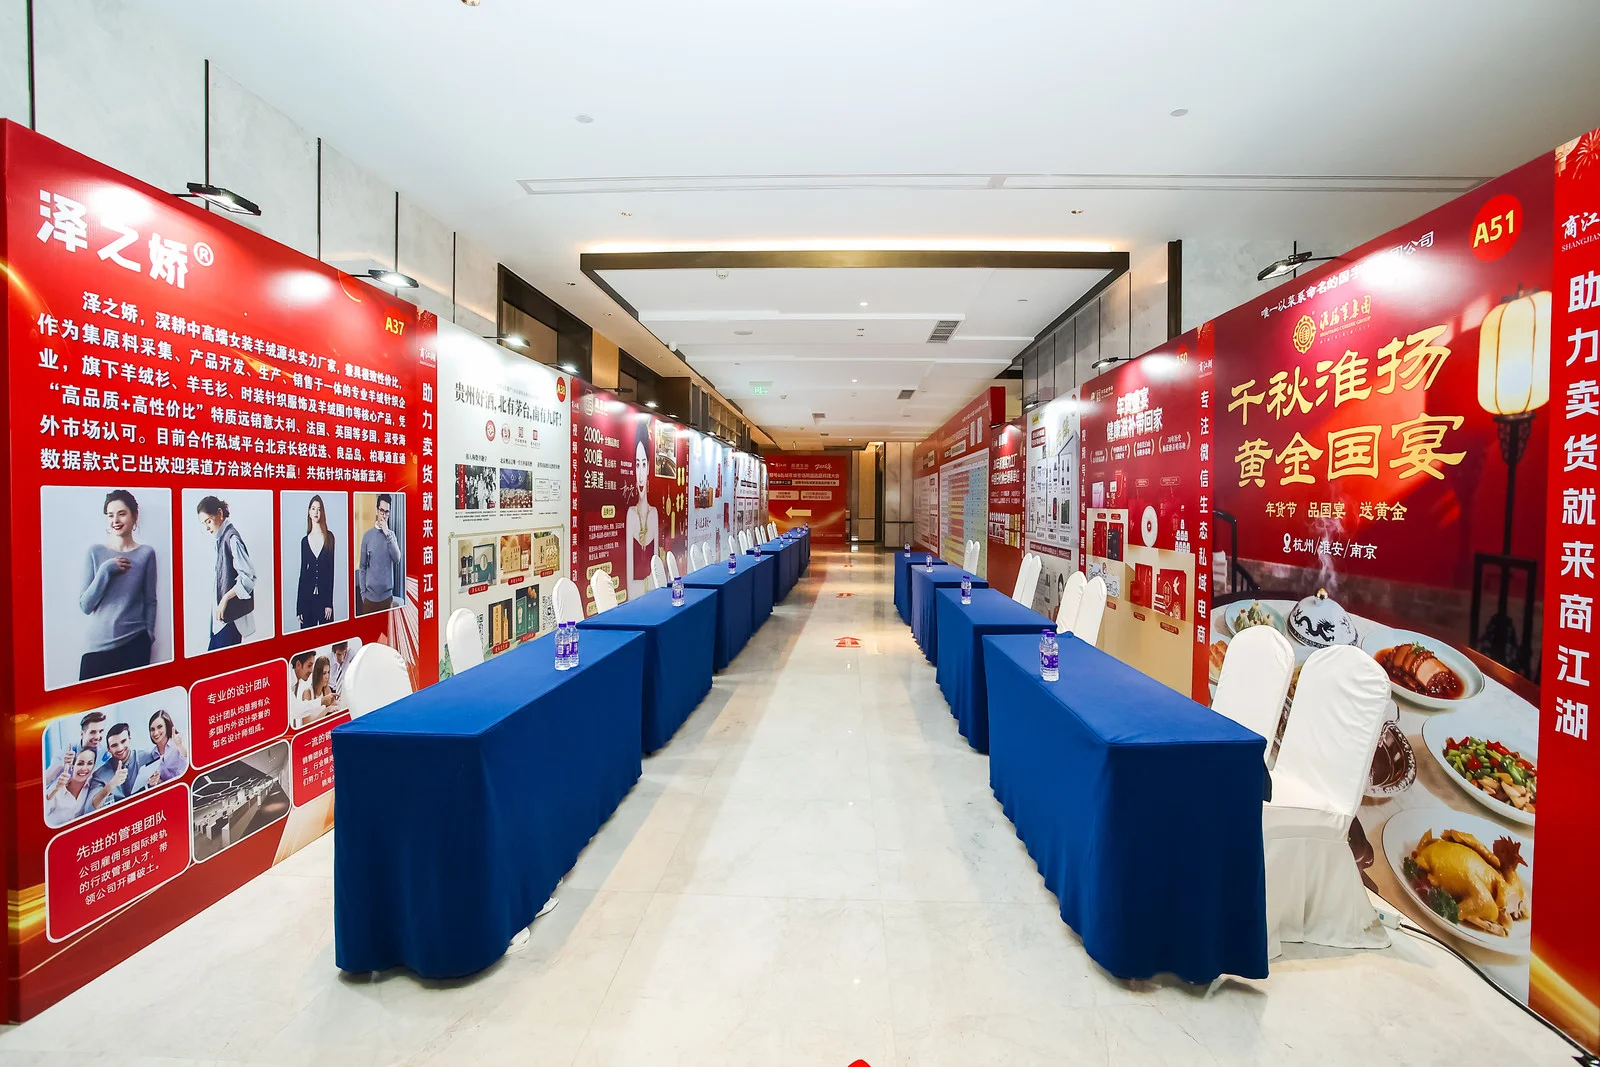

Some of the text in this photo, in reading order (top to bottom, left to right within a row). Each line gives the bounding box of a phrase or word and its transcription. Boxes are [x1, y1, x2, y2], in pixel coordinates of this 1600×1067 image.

[1472, 210, 1516, 248] A51
[385, 317, 405, 336] A37
[1228, 324, 1452, 426] 千秋淮扬
[1234, 412, 1467, 488] 黄金国宴
[422, 382, 434, 620] 助力卖货就来商江湖
[1264, 501, 1408, 521] 年货节 品国宴 送黄金
[1555, 272, 1600, 742] 助力卖货就来商江湖
[206, 676, 271, 705] 专业的设计团队
[76, 810, 167, 862] 先进的管理团队
